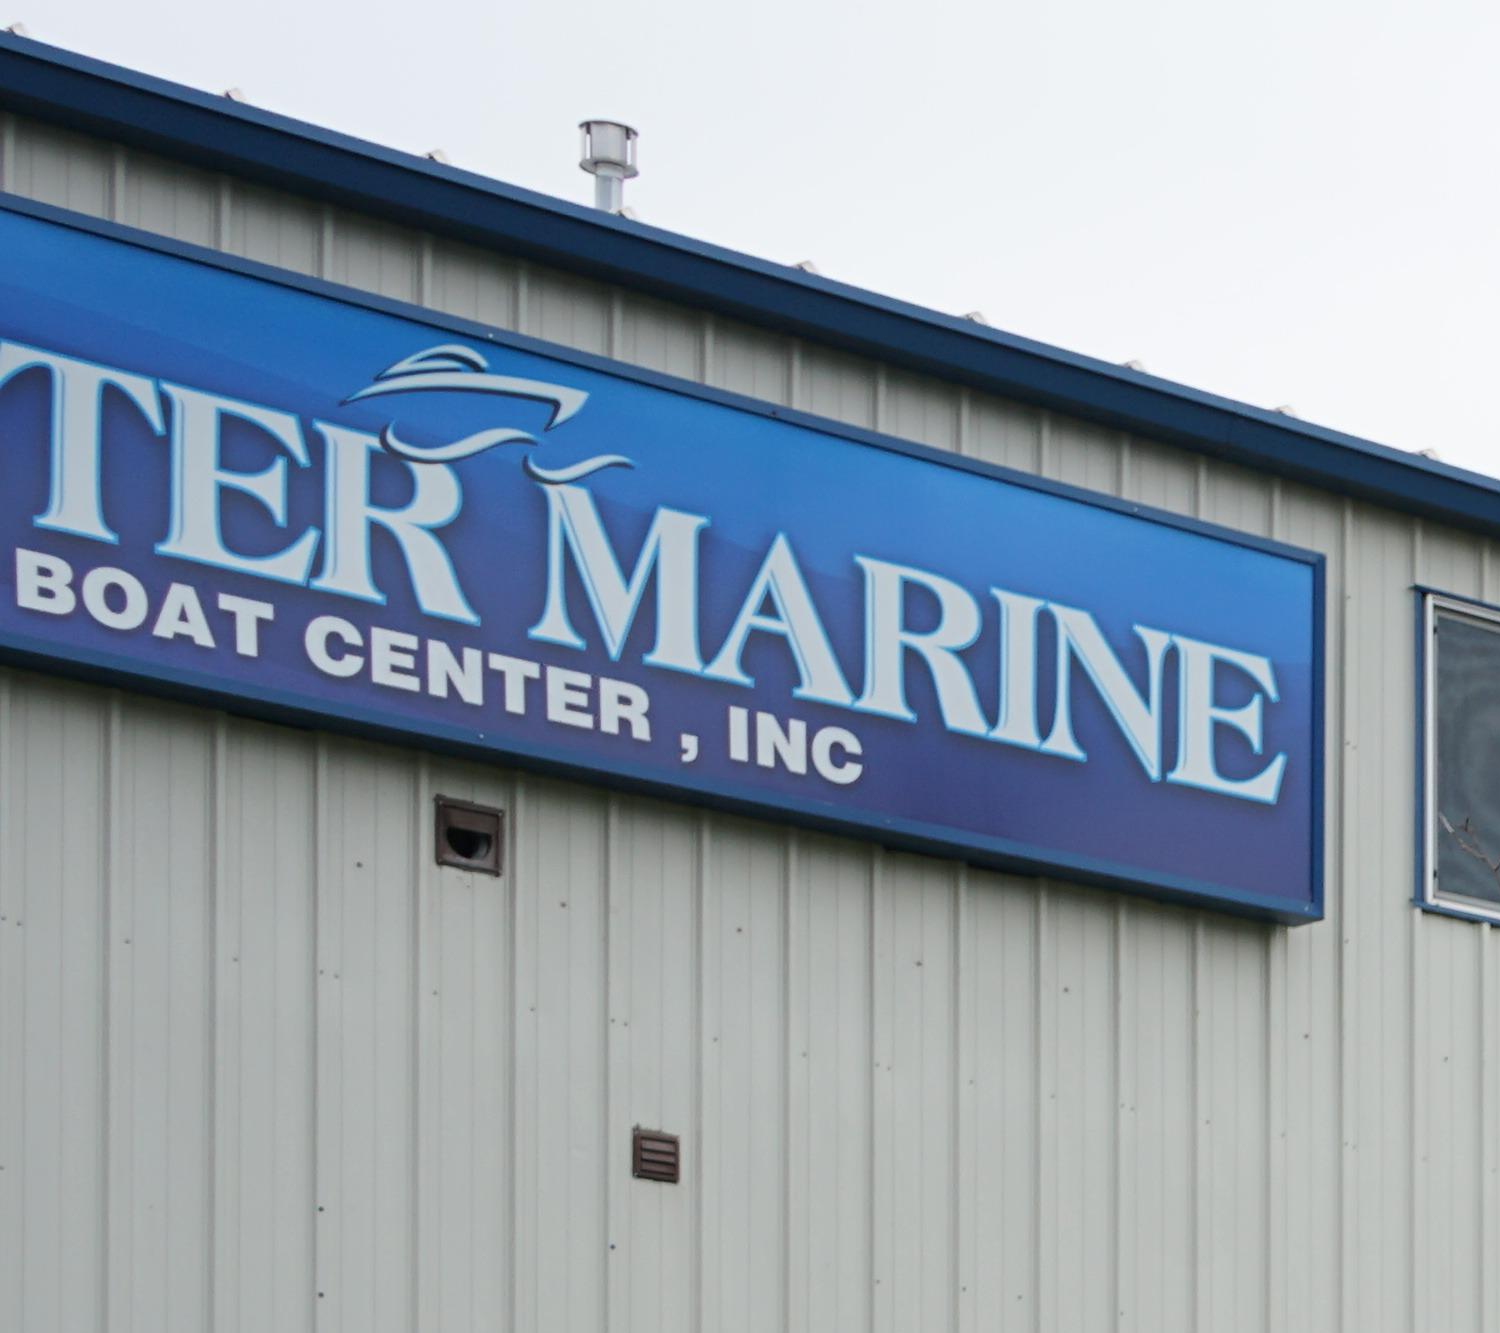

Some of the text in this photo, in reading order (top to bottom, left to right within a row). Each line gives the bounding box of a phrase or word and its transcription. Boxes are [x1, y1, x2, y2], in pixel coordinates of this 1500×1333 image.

[0, 339, 1287, 804] TER MARINE
[15, 547, 274, 659] BOAT
[304, 613, 652, 741] CENTER
[729, 705, 865, 786] INC
